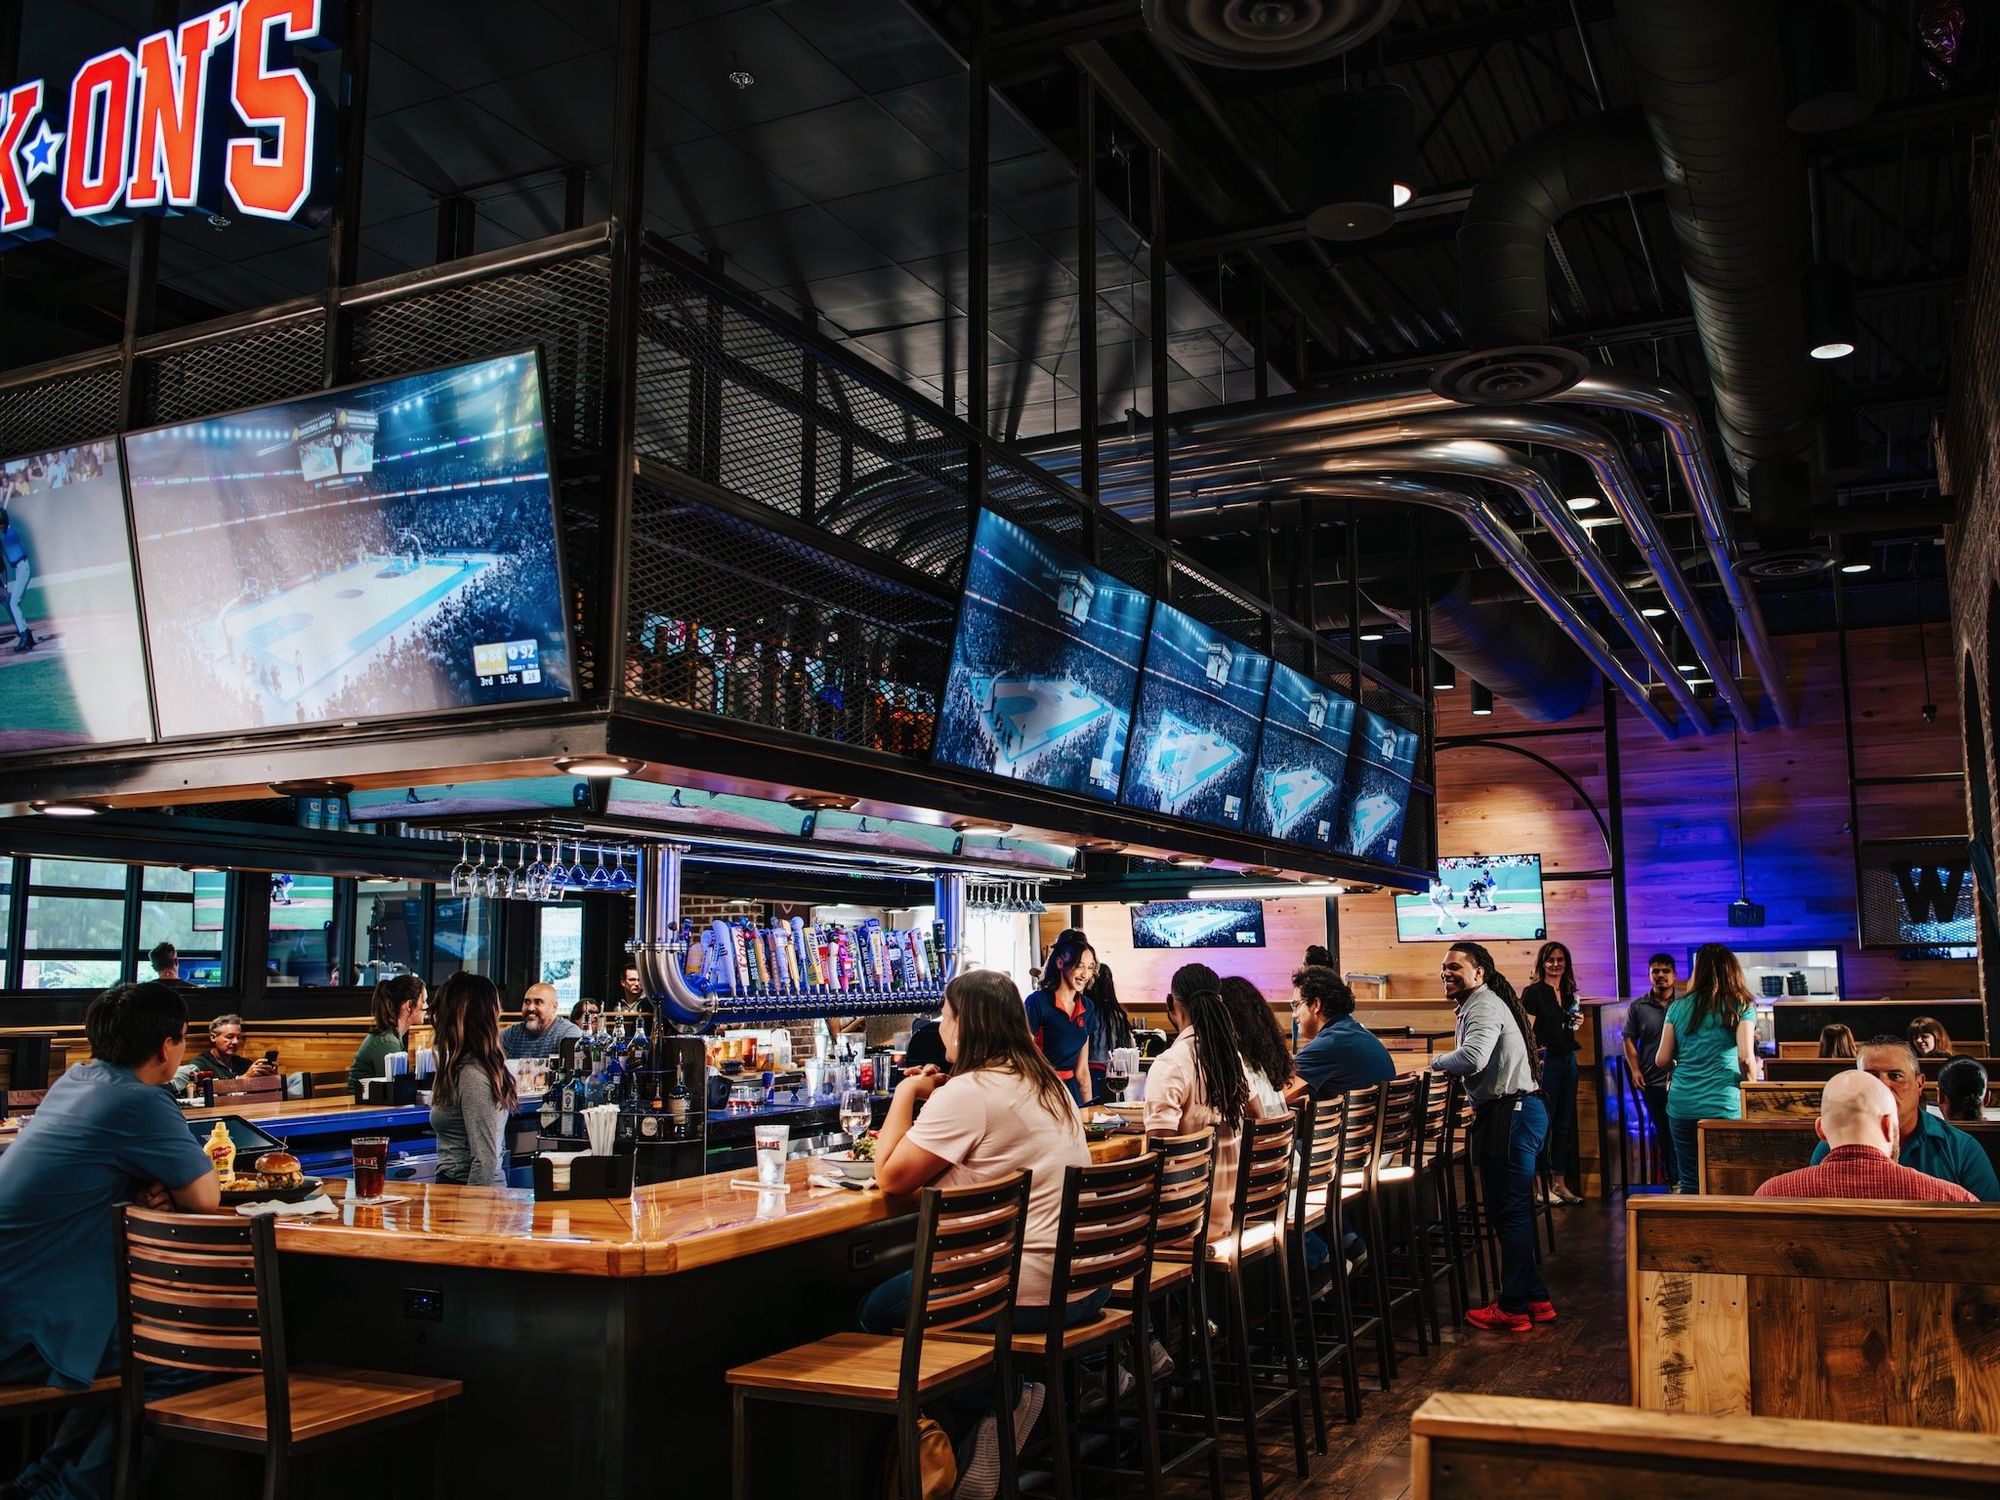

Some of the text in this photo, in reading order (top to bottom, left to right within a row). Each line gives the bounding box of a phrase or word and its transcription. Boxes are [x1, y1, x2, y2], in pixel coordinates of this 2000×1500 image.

[62, 0, 322, 222] ON'S
[520, 645, 535, 660] 92
[480, 676, 494, 687] 3rd
[500, 674, 518, 686] 1:56
[1886, 859, 1972, 924] W
[906, 956, 917, 986] TRULY
